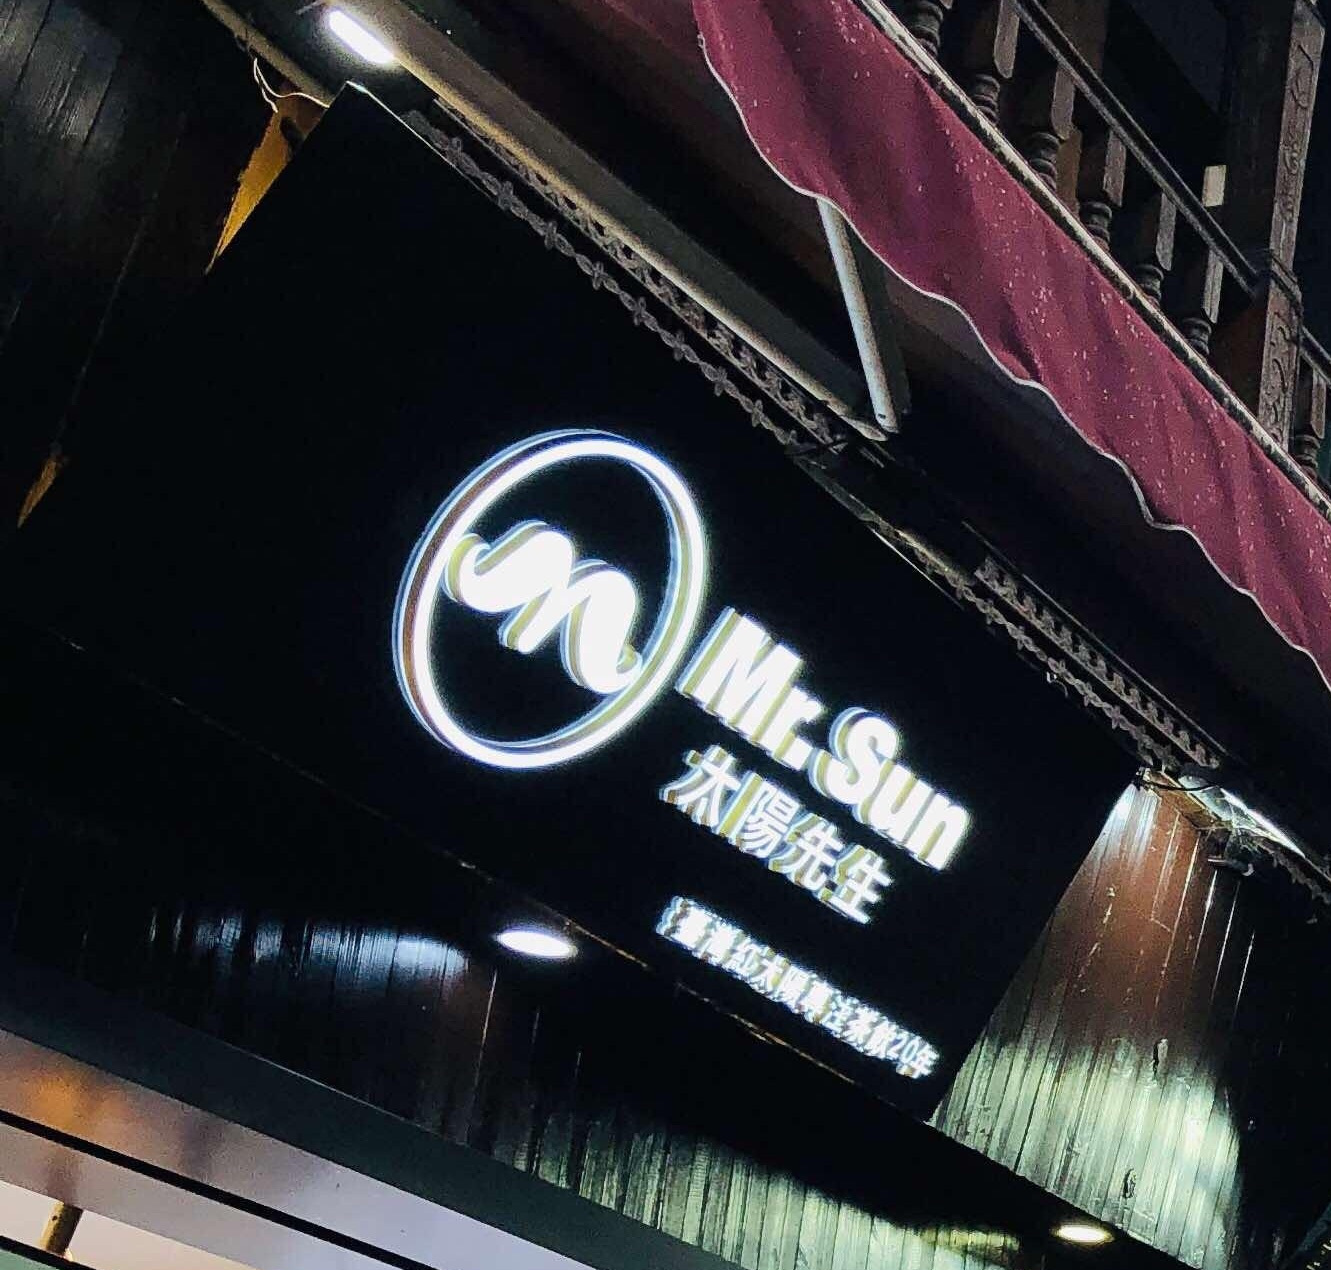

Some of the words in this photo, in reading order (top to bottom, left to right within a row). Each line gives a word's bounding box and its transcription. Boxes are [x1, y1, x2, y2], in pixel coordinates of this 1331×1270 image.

[659, 744, 893, 924] 太陽先生
[675, 607, 972, 871] Mr.Sun
